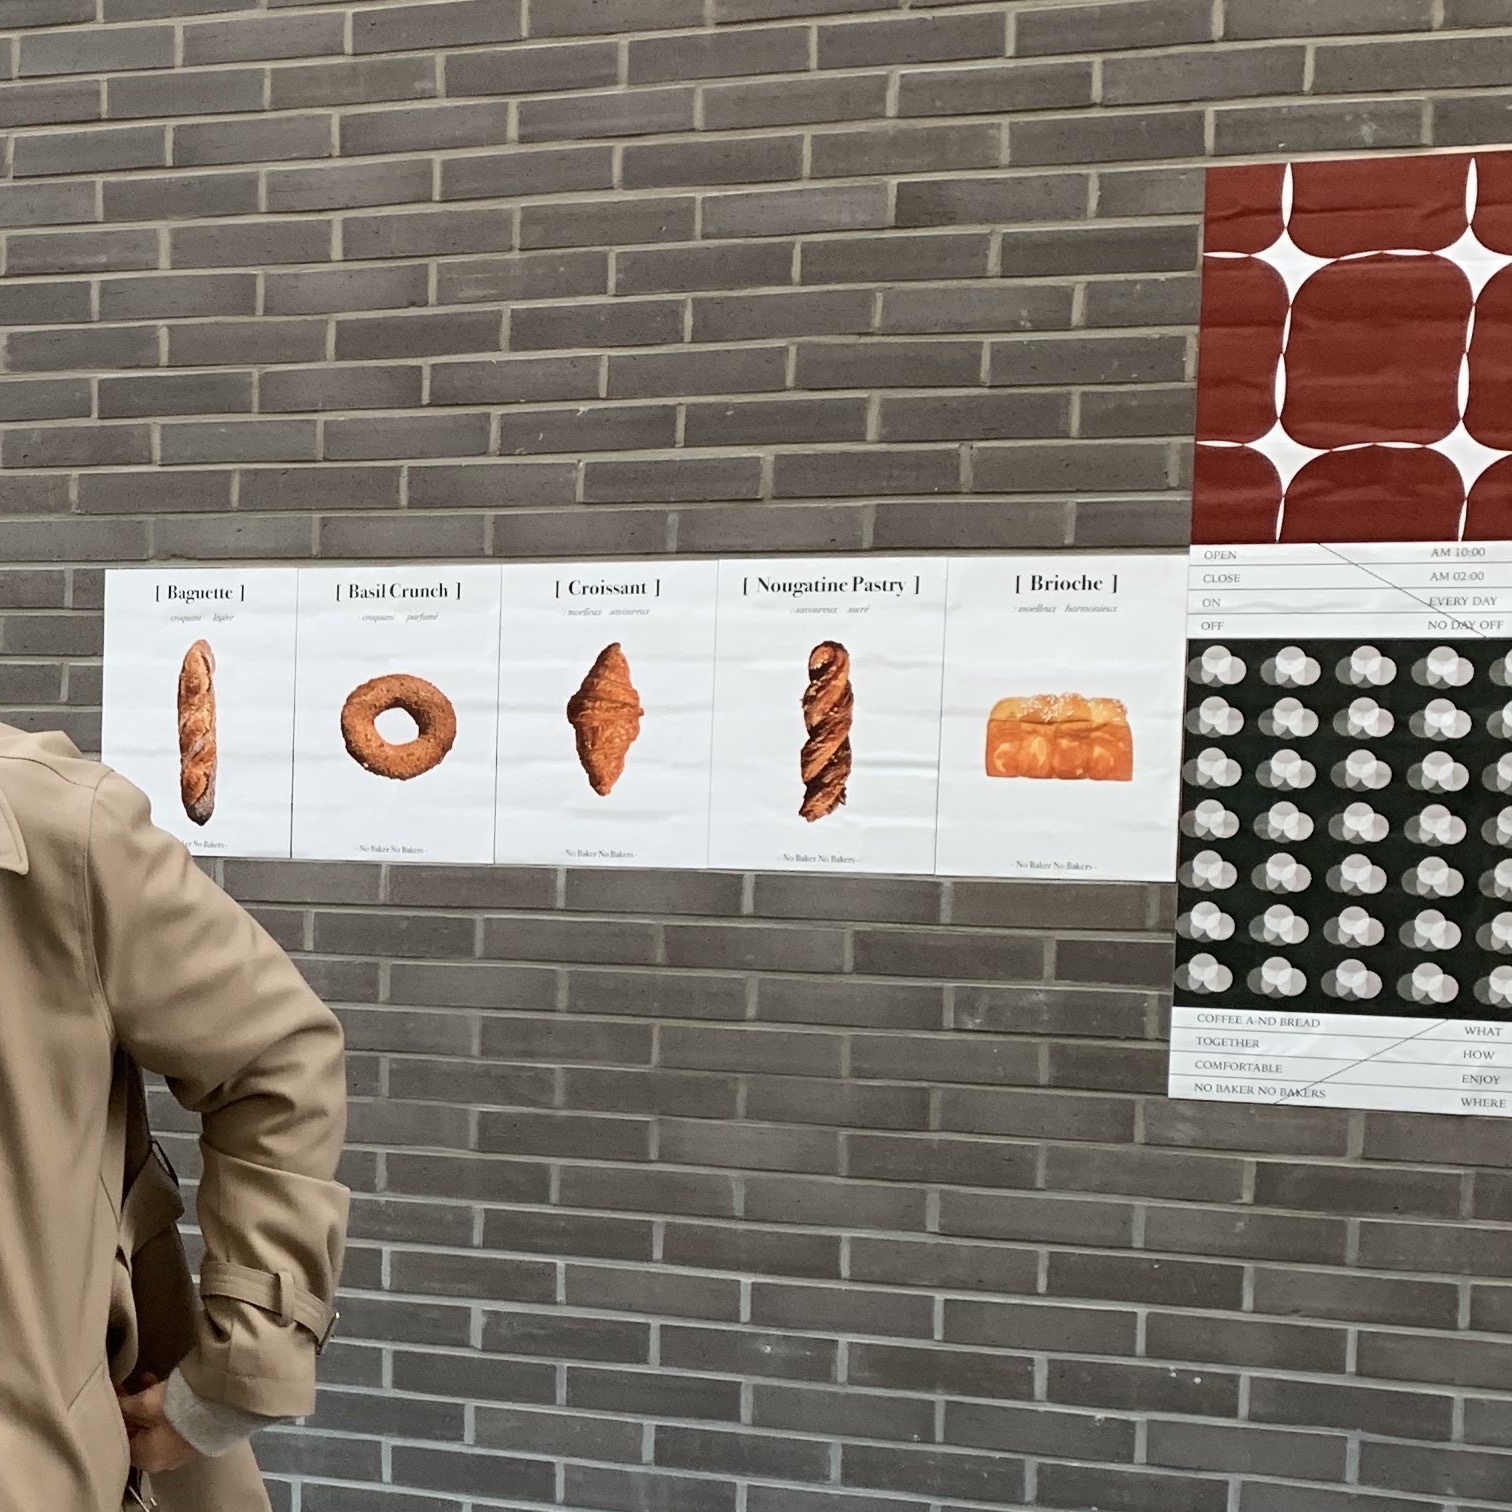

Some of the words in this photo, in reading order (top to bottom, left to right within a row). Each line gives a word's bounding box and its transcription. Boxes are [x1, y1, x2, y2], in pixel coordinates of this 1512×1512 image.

[1204, 550, 1237, 560] OPEN
[1431, 547, 1451, 557] AM
[1455, 547, 1486, 557] 10:00
[1203, 574, 1241, 583] CLOSE
[1430, 572, 1450, 581] AM
[1453, 571, 1485, 581] 02:00
[568, 579, 647, 595] Croissant
[757, 576, 848, 598] Nougatine
[852, 575, 906, 597] Pastry
[1031, 574, 1103, 591] Brioche
[168, 585, 233, 604] Baguette
[349, 584, 386, 598] Basil
[389, 582, 448, 598] Crunch
[1202, 598, 1221, 607] ON
[1429, 596, 1468, 606] EVERY
[1472, 596, 1498, 606] DAY
[1201, 621, 1224, 631] OFF
[1428, 621, 1448, 630] NO
[1451, 620, 1476, 630] DAY
[1479, 620, 1504, 630] OFF
[1197, 1014, 1243, 1025] COFFEE
[1280, 1018, 1321, 1028] BREAD
[1464, 1026, 1503, 1036] WHAT
[1196, 1036, 1260, 1048] TOGETHER
[1463, 1050, 1495, 1060] HOW
[1194, 1060, 1283, 1073] COMFORTABLE
[1462, 1074, 1501, 1085] ENJOY
[1194, 1083, 1213, 1093] NO
[1215, 1084, 1255, 1095] BAKER
[1258, 1086, 1277, 1096] NO
[1279, 1087, 1327, 1099] BAKERS
[1461, 1098, 1507, 1109] WHERE
